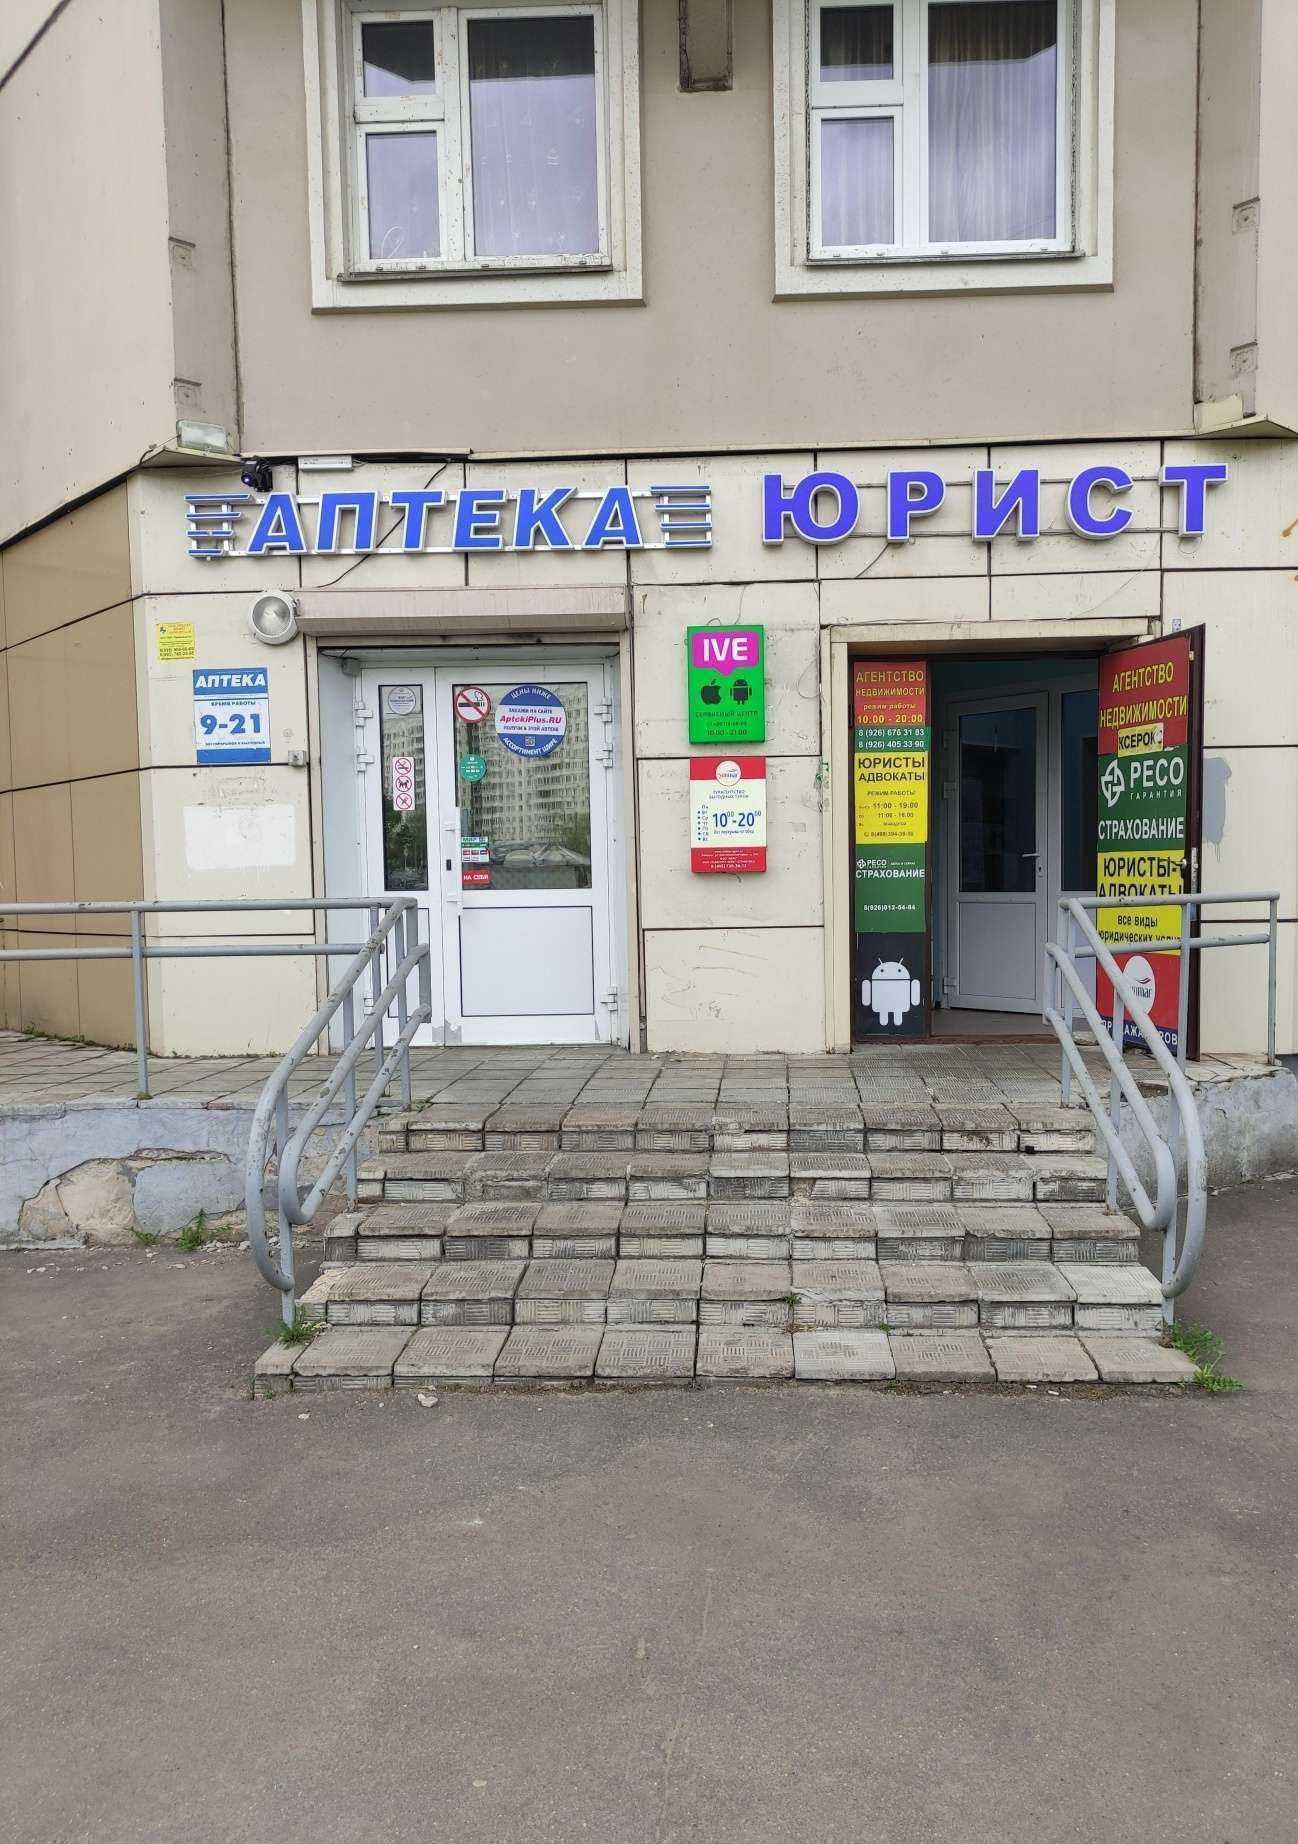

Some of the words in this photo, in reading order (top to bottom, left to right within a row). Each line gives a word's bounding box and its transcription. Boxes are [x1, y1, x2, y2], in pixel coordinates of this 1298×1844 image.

[762, 464, 1227, 545] ЮРИСТ
[247, 485, 644, 555] АПТЕКА
[703, 637, 748, 662] IVE
[195, 673, 266, 688] АПТЕКА
[856, 670, 924, 683] АГЕНТСТВО
[1112, 662, 1174, 693] АГЕНТСТВО
[856, 687, 925, 697] НЕДВИЖИМОСТИ
[1100, 695, 1187, 729] НЕДВИЖИМОСТИ
[200, 713, 261, 735] 9-21
[500, 715, 562, 724] AptekiPlus.RU
[857, 714, 884, 724] 10:00
[895, 714, 923, 723] 20:00
[865, 729, 885, 737] (926)
[865, 741, 885, 749] (926)
[858, 757, 925, 769] ЮРИСТЫ
[858, 772, 925, 783] АДВОКАТЫ
[1130, 757, 1184, 788] РЕСО
[1130, 789, 1182, 800] ГАРАНТИЯ
[1098, 817, 1185, 840] СТРАХОВАНИЕ
[855, 868, 925, 878] СТРАХОВАНИЕ
[1117, 915, 1132, 925] все
[1134, 916, 1158, 928] виды
